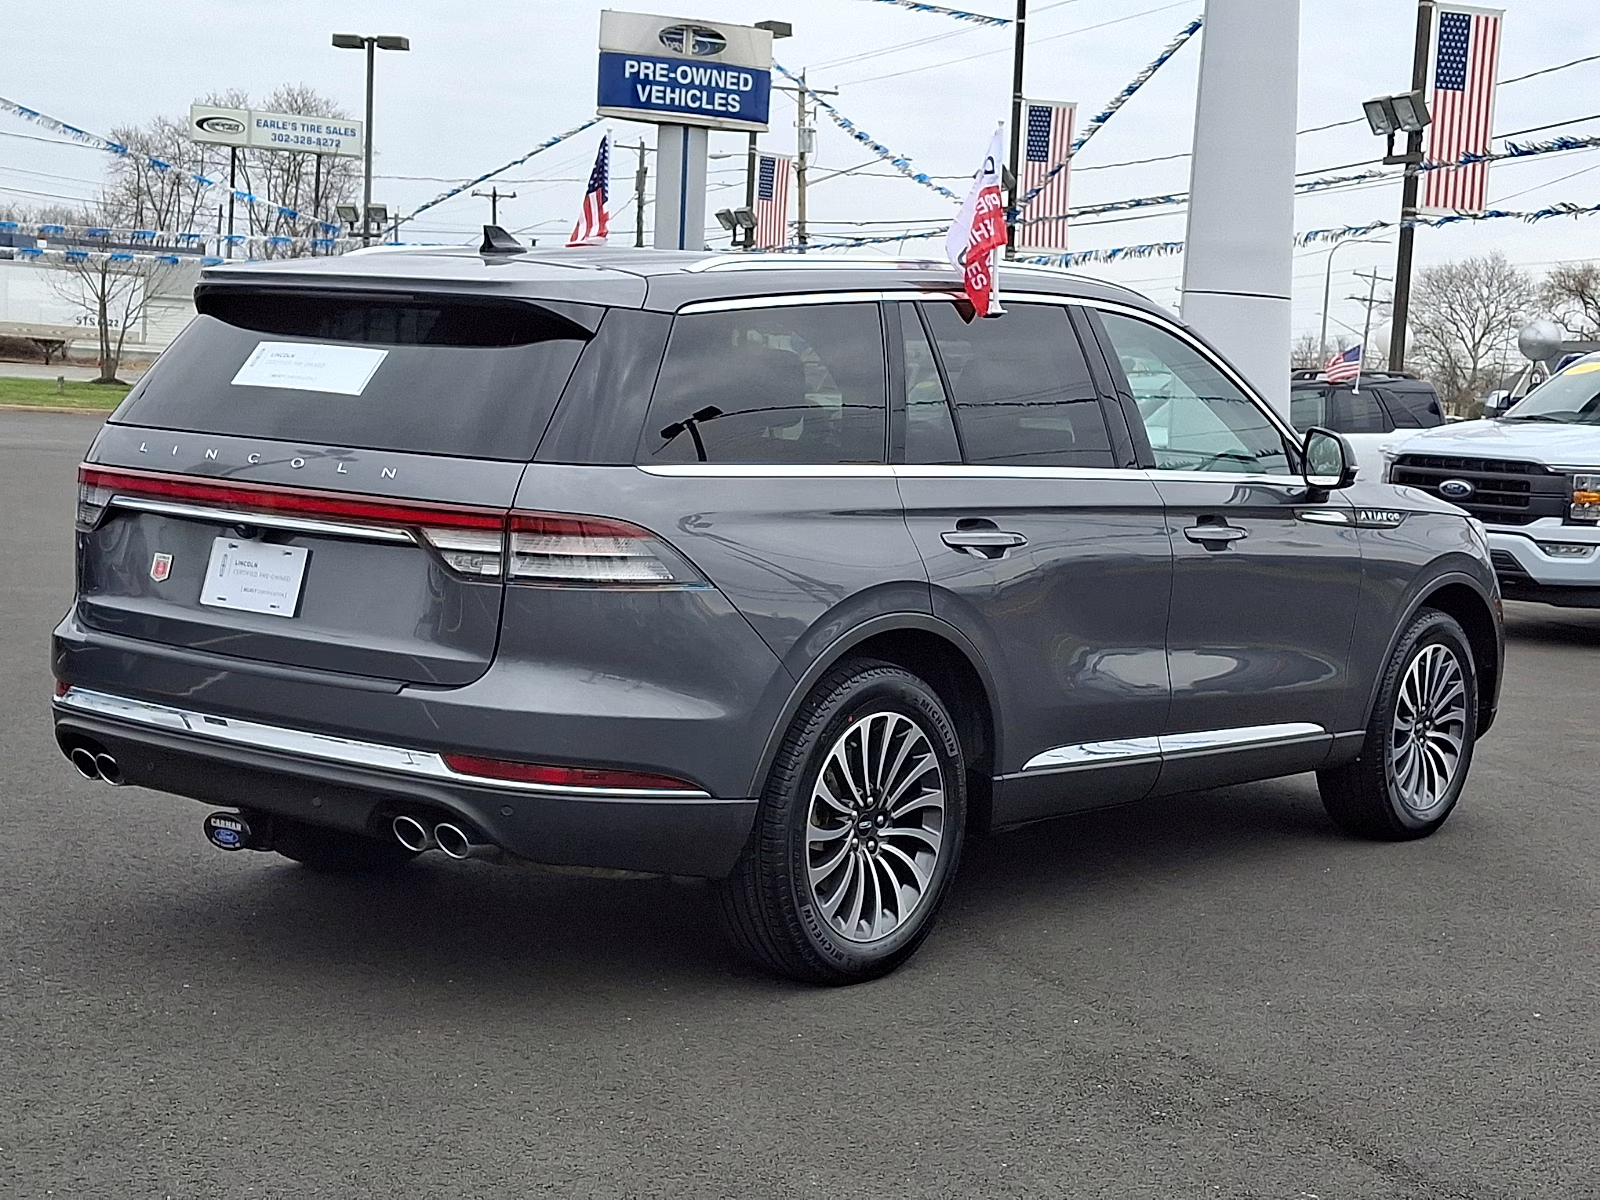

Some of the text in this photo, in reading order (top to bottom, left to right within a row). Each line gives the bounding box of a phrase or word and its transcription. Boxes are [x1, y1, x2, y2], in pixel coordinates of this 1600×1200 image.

[624, 59, 754, 92] PRE-OWNED
[636, 83, 741, 113] VEHICLES
[255, 118, 357, 138] EARLE'S TIRE SALES
[139, 442, 398, 480] LINCOLN
[1360, 510, 1400, 521] AVIATOR
[234, 560, 258, 568] LINCOLN
[919, 699, 956, 754] MICHELIN
[803, 907, 846, 962] MICHELIN
